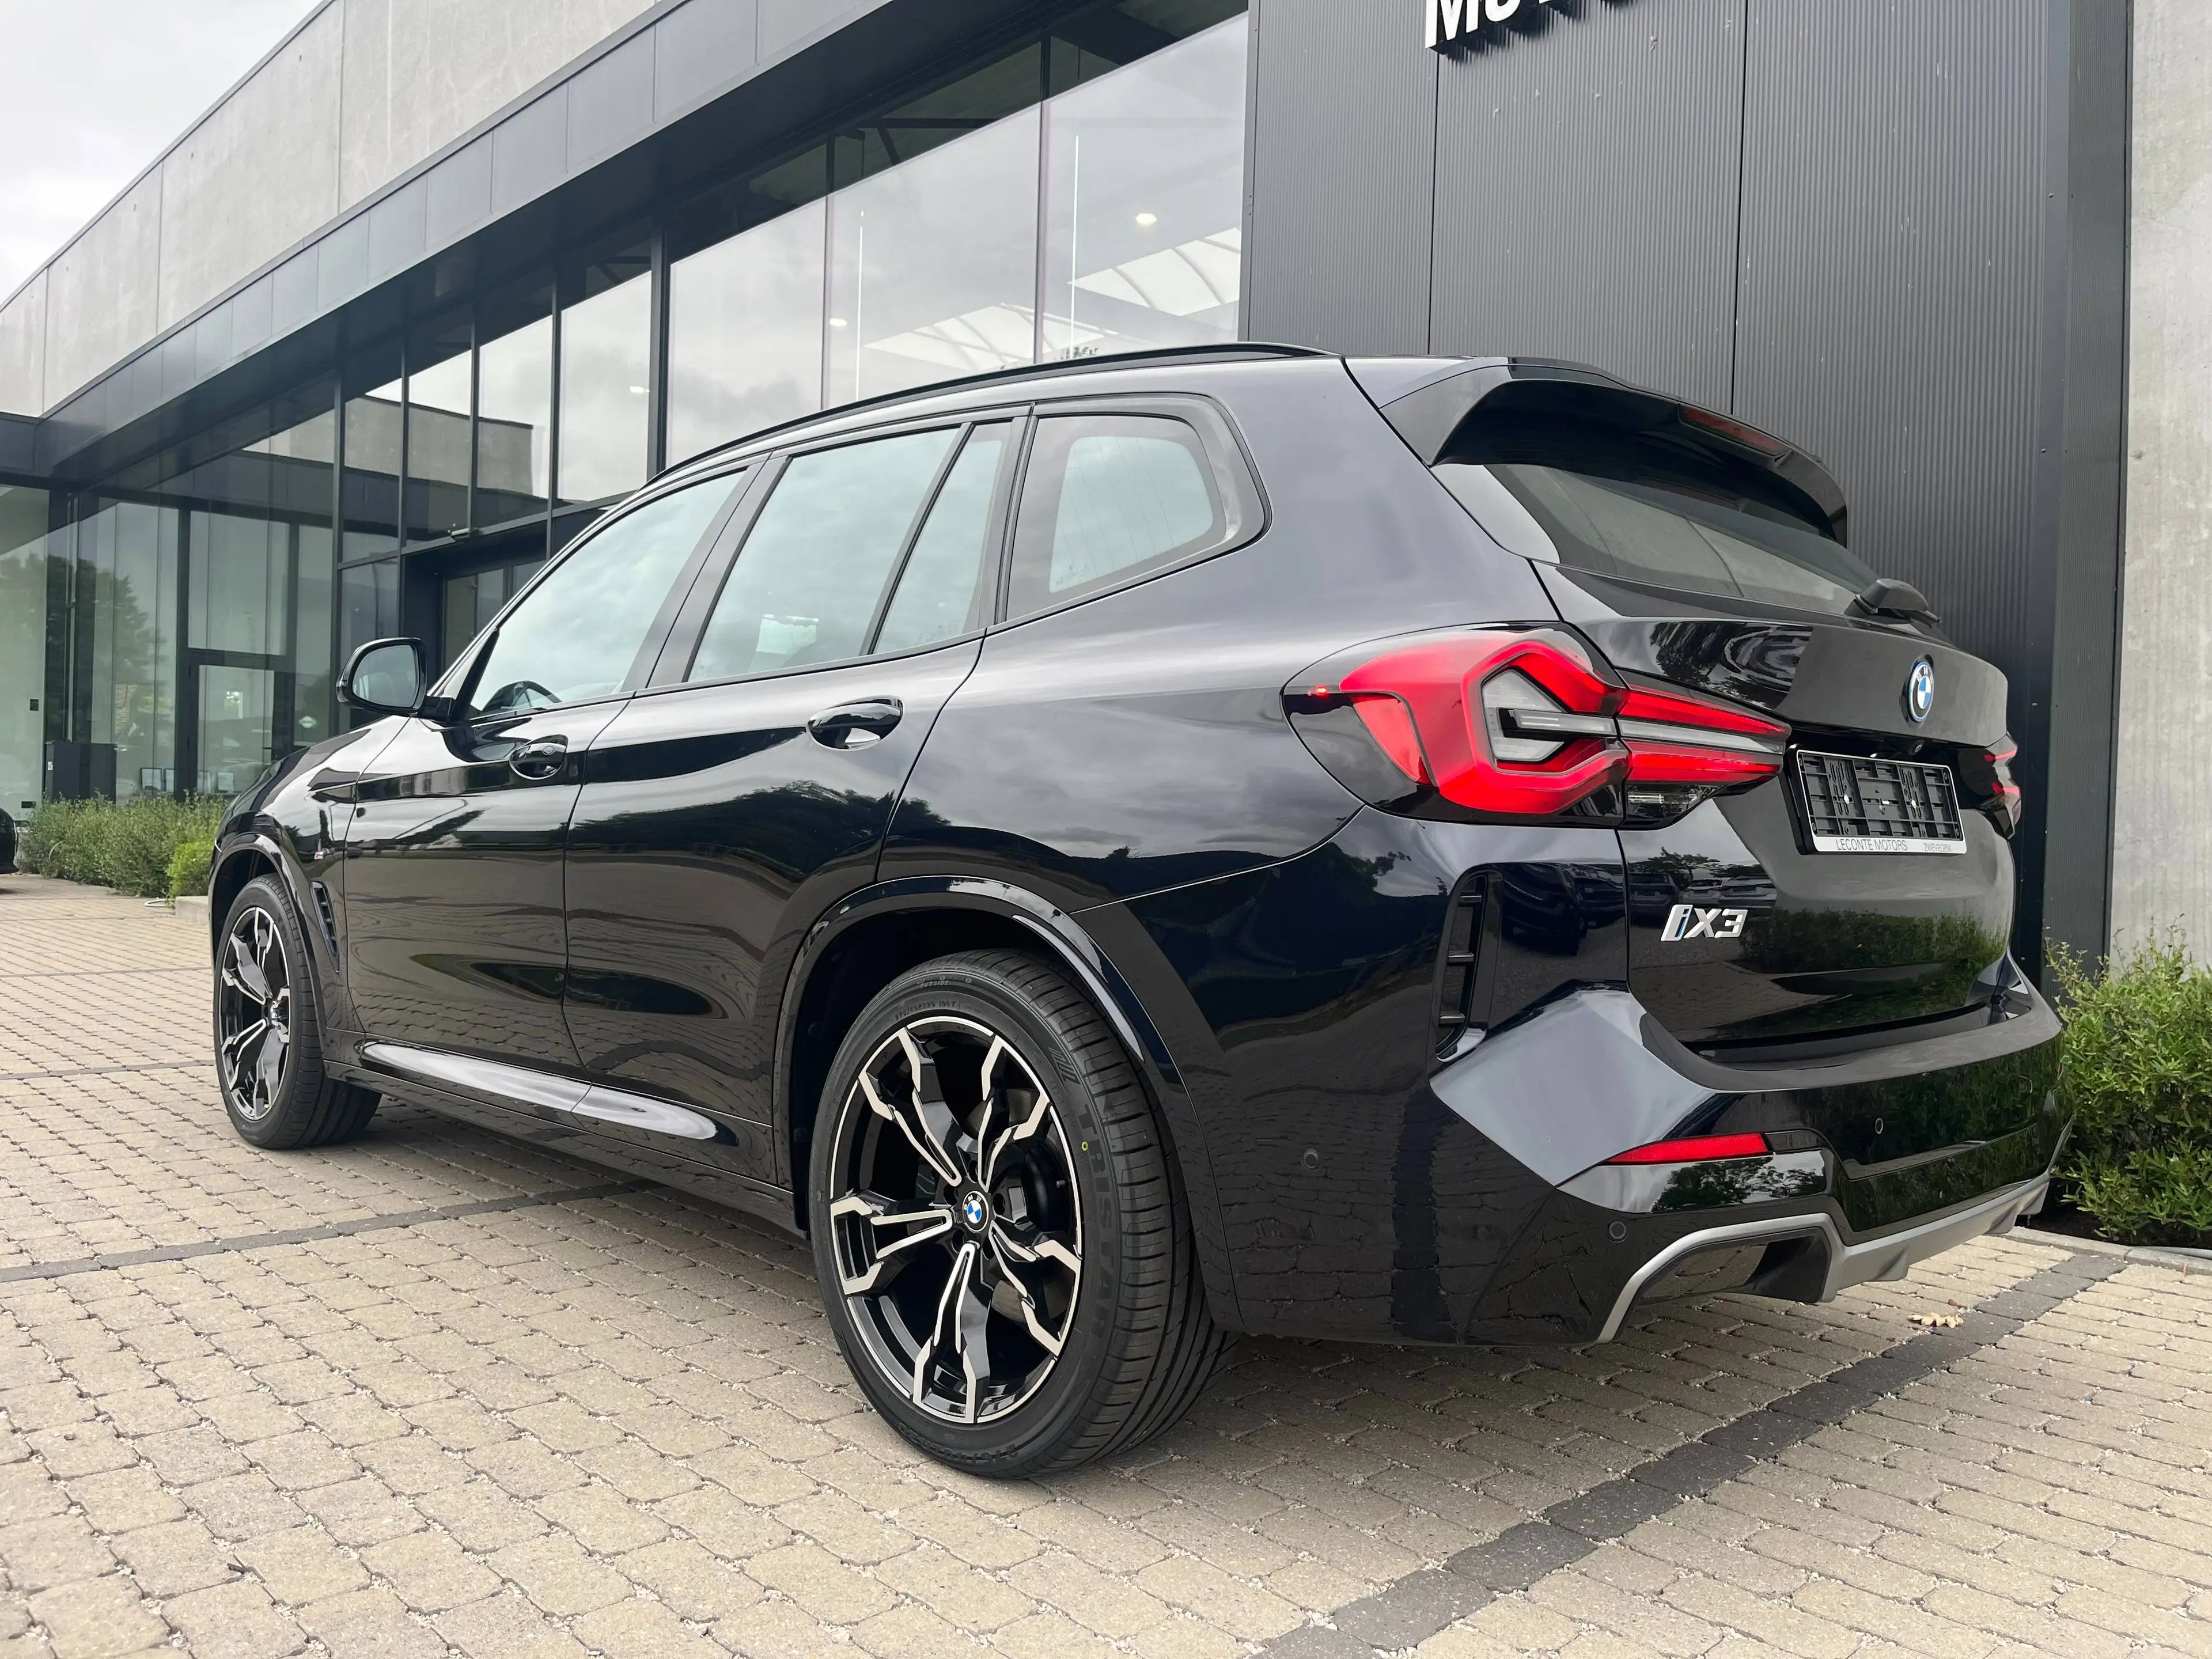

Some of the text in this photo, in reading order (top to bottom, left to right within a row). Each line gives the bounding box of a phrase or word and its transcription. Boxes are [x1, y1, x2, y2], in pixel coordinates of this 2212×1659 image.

[1836, 839, 1908, 851] LECONTE MOTORS
[1660, 904, 1748, 941] iX3
[919, 980, 949, 988] OUTSIDE
[1078, 1103, 1115, 1339] TRISTAR
